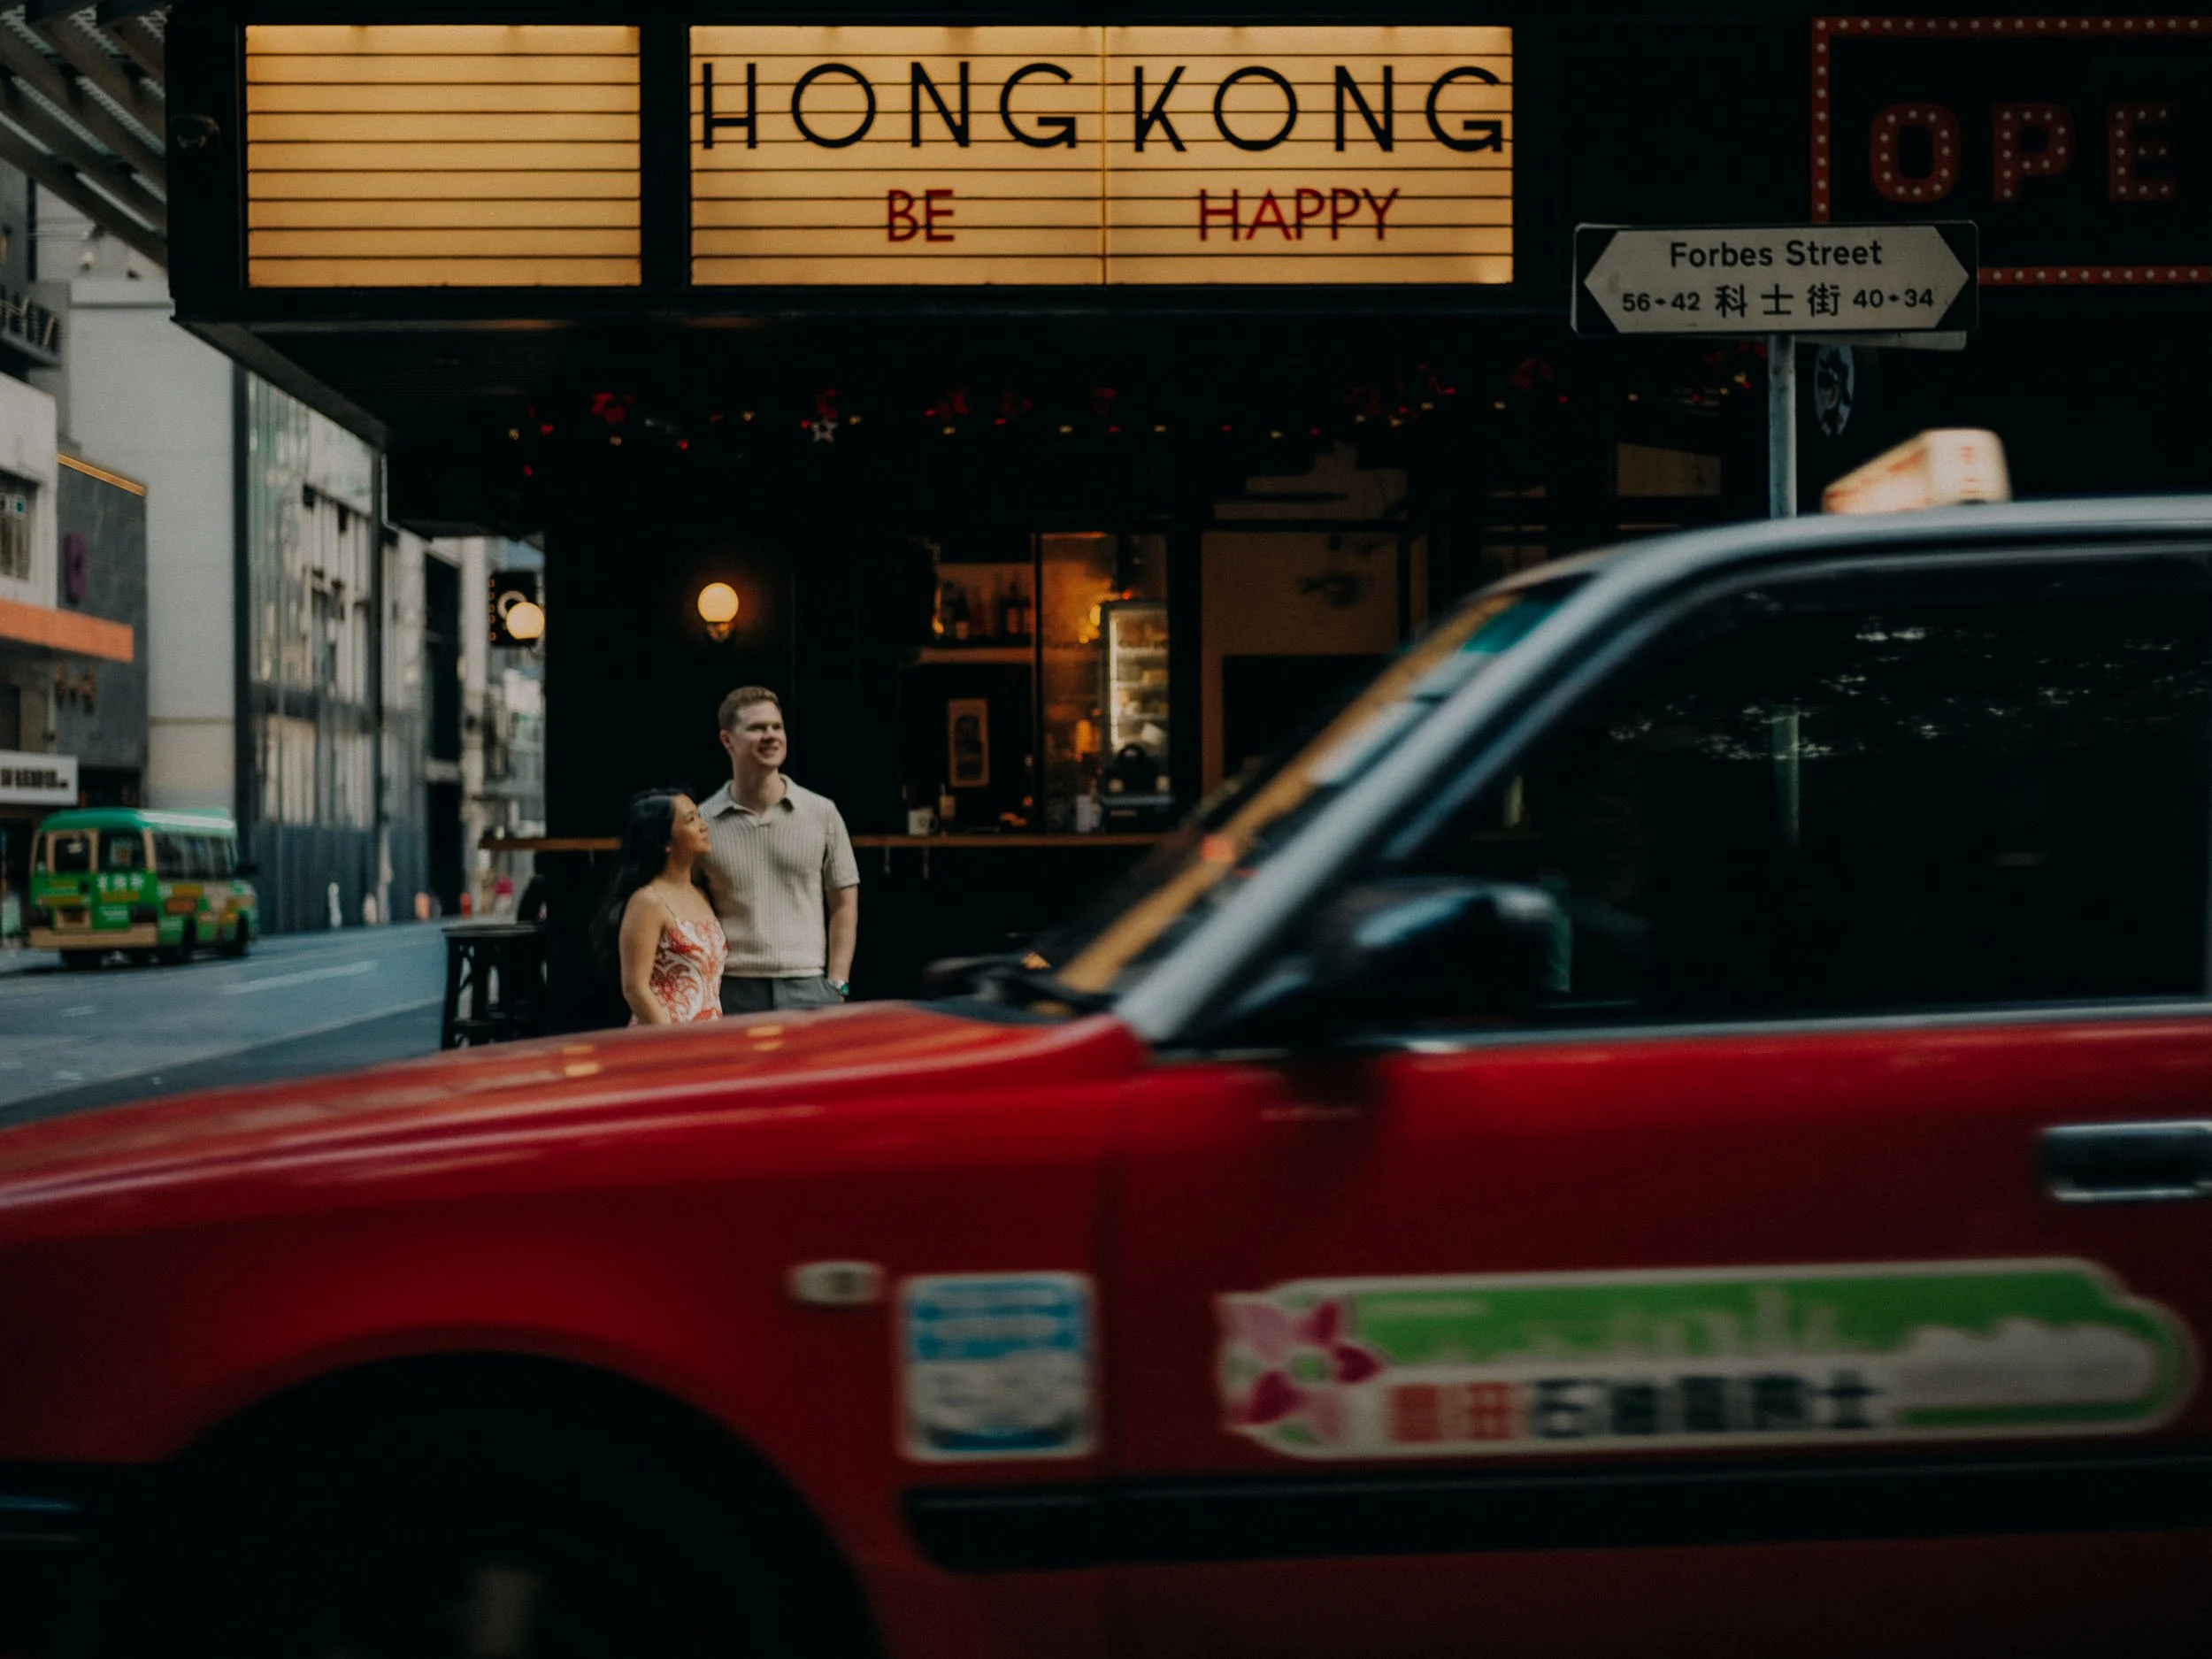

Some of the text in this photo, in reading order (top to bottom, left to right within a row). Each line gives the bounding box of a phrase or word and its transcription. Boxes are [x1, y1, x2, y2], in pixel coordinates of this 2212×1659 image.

[703, 61, 1502, 152] HONG KONG
[1868, 100, 2180, 204] OPE
[888, 188, 1399, 242] BE HAPPY
[1671, 240, 1883, 267] Forbes Street
[1715, 282, 1840, 318] 科士街
